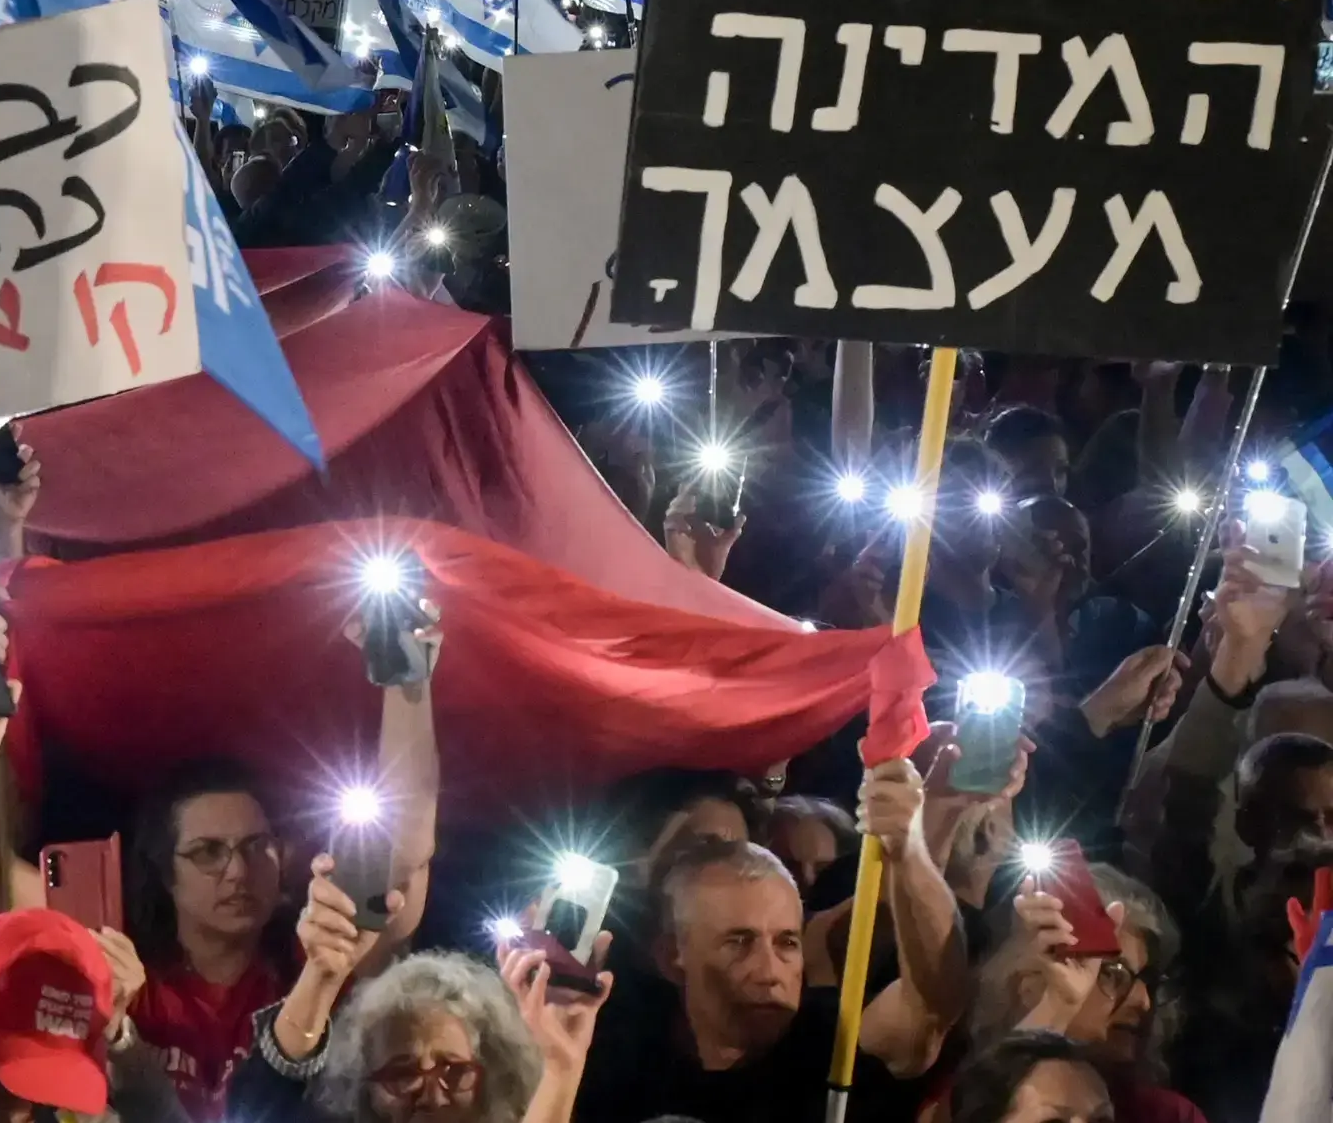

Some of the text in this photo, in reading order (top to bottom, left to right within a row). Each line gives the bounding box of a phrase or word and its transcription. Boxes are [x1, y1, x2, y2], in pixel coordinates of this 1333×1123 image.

[702, 12, 1287, 151] המדינה
[640, 166, 1203, 331] מעצמך
[72, 262, 178, 376] קו
